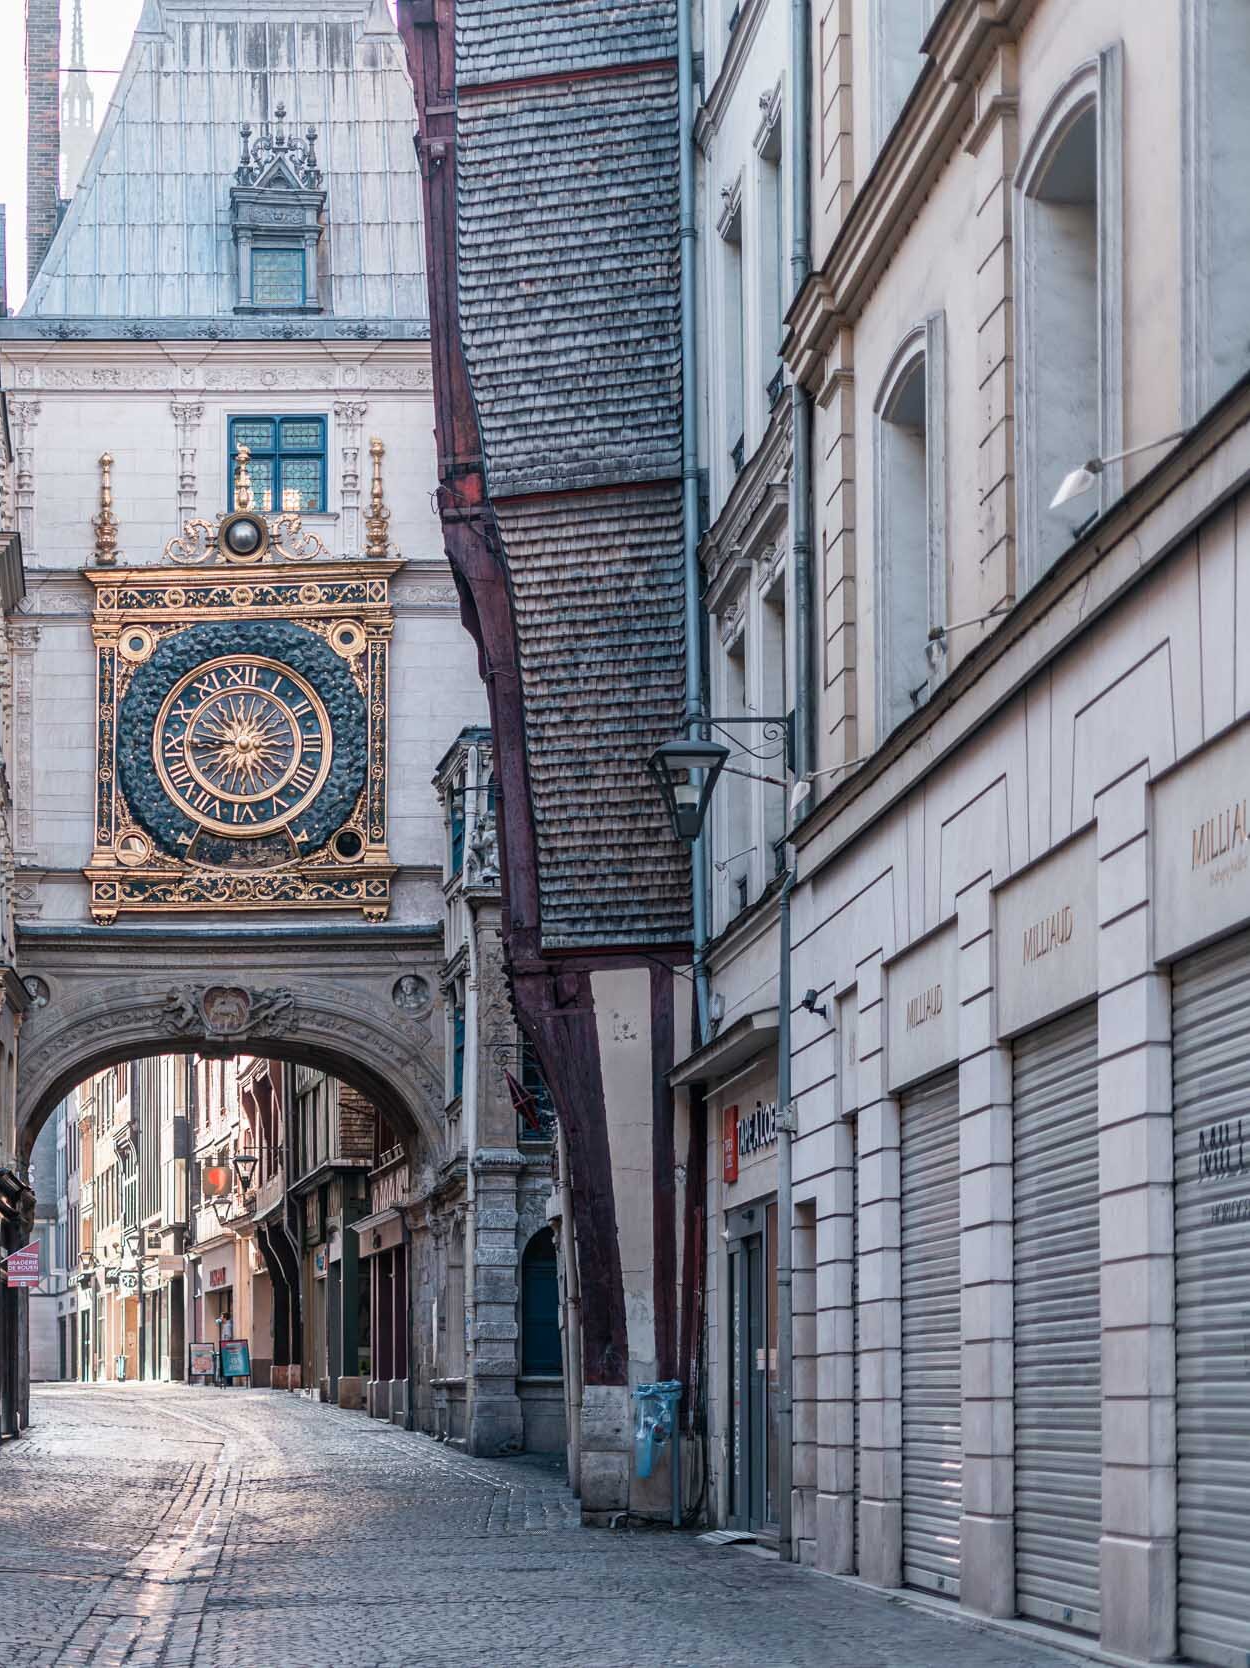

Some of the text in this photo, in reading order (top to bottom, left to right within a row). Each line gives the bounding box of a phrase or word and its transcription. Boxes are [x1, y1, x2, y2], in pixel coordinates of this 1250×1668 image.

[192, 672, 222, 700] XI
[225, 666, 258, 686] XII
[270, 675, 283, 693] I
[171, 700, 195, 723] X
[292, 699, 312, 718] II
[165, 733, 184, 758] IX
[302, 733, 321, 752] III
[168, 761, 196, 800] VIII
[193, 790, 222, 819] VII
[233, 804, 258, 822] VI
[272, 795, 290, 816] V
[1022, 906, 1073, 967] MILLIAUD
[906, 984, 943, 1033] MILLIAUD
